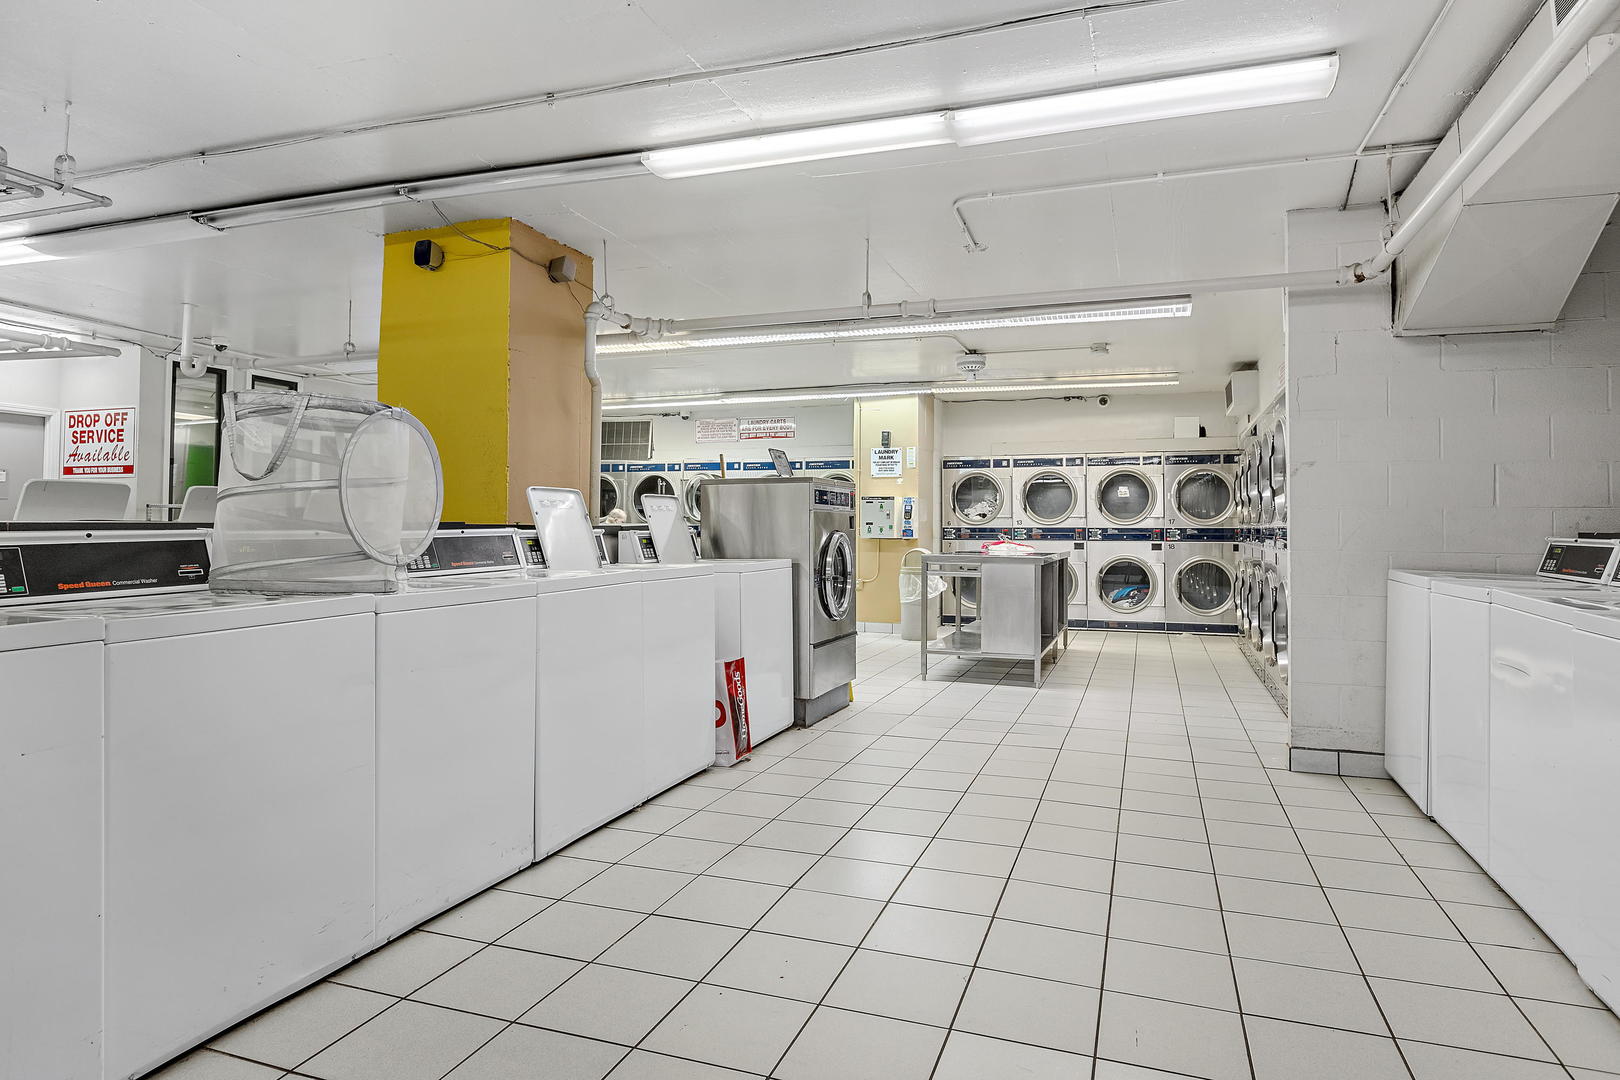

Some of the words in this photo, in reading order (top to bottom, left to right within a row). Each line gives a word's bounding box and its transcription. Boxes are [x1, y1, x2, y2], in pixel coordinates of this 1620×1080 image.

[68, 414, 100, 429] DROP
[104, 412, 128, 427] OFF
[71, 428, 125, 445] SERVICE
[66, 444, 130, 463] Available
[57, 582, 84, 590] Speed
